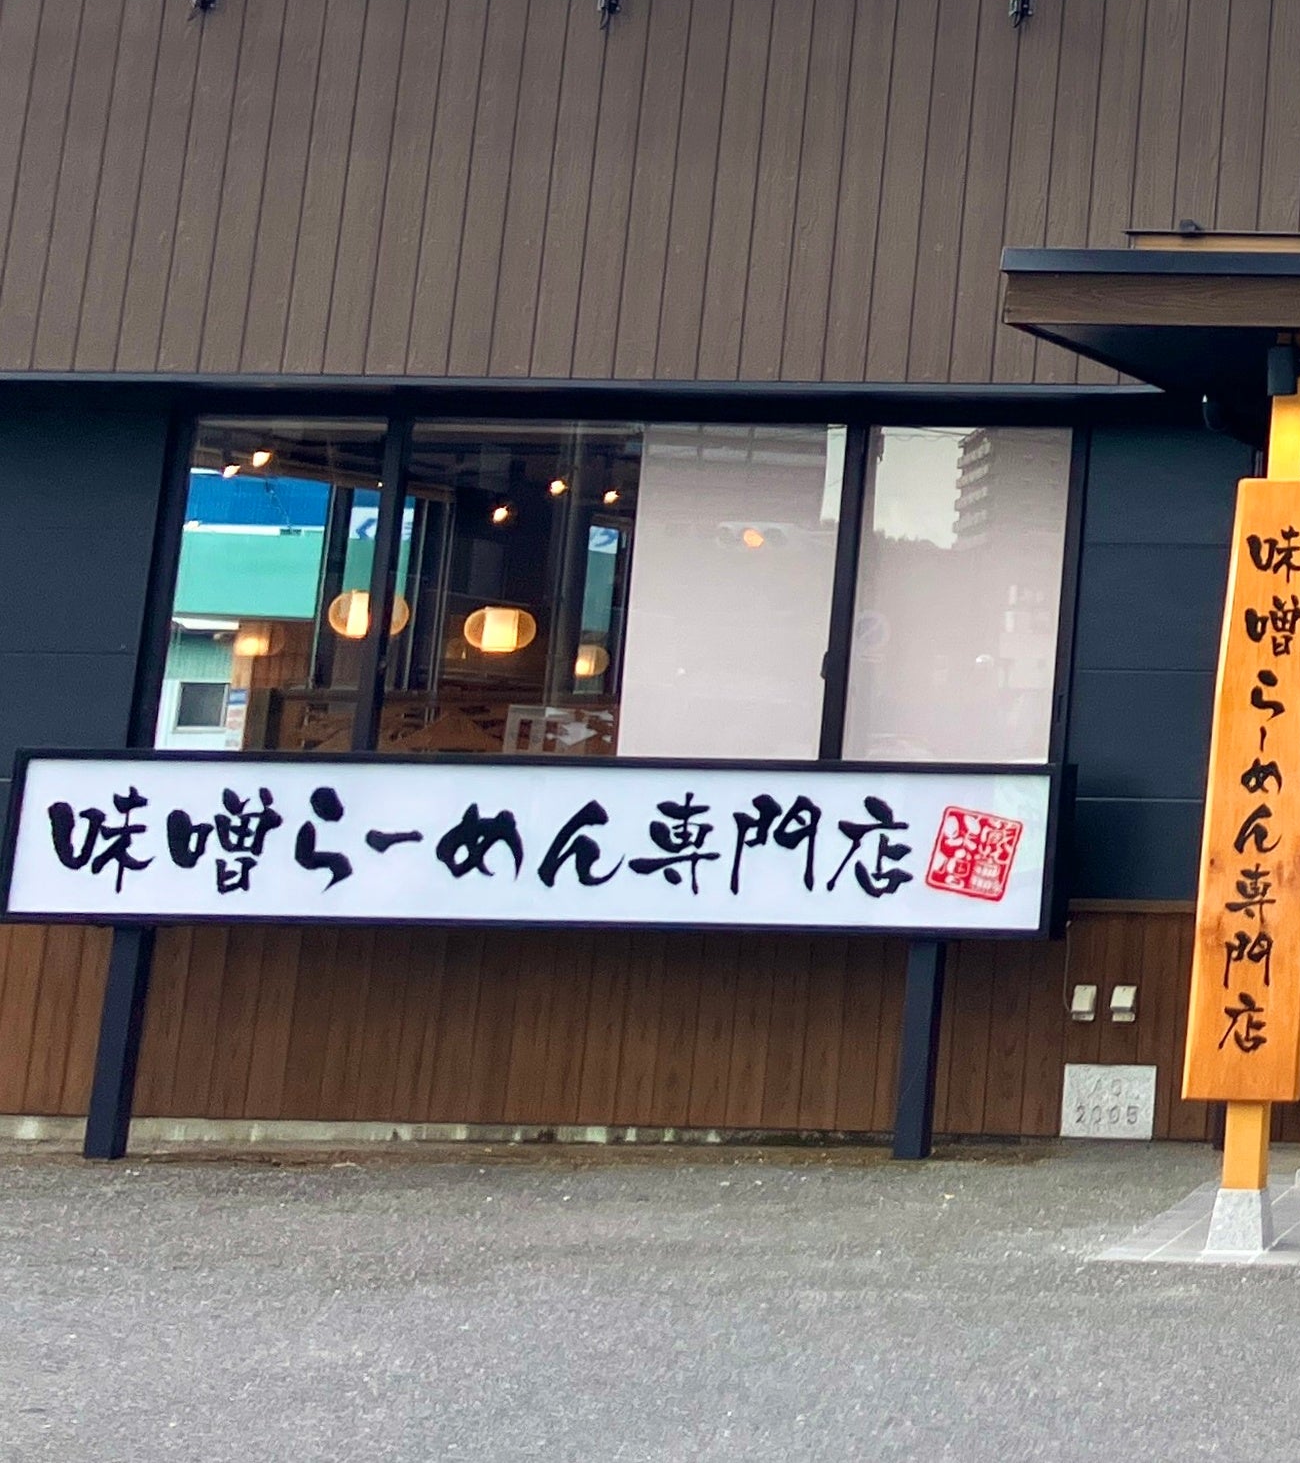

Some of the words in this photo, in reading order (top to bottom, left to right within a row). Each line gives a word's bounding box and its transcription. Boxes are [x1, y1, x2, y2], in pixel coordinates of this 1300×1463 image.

[48, 786, 914, 898] 味噌らーめん専門店
